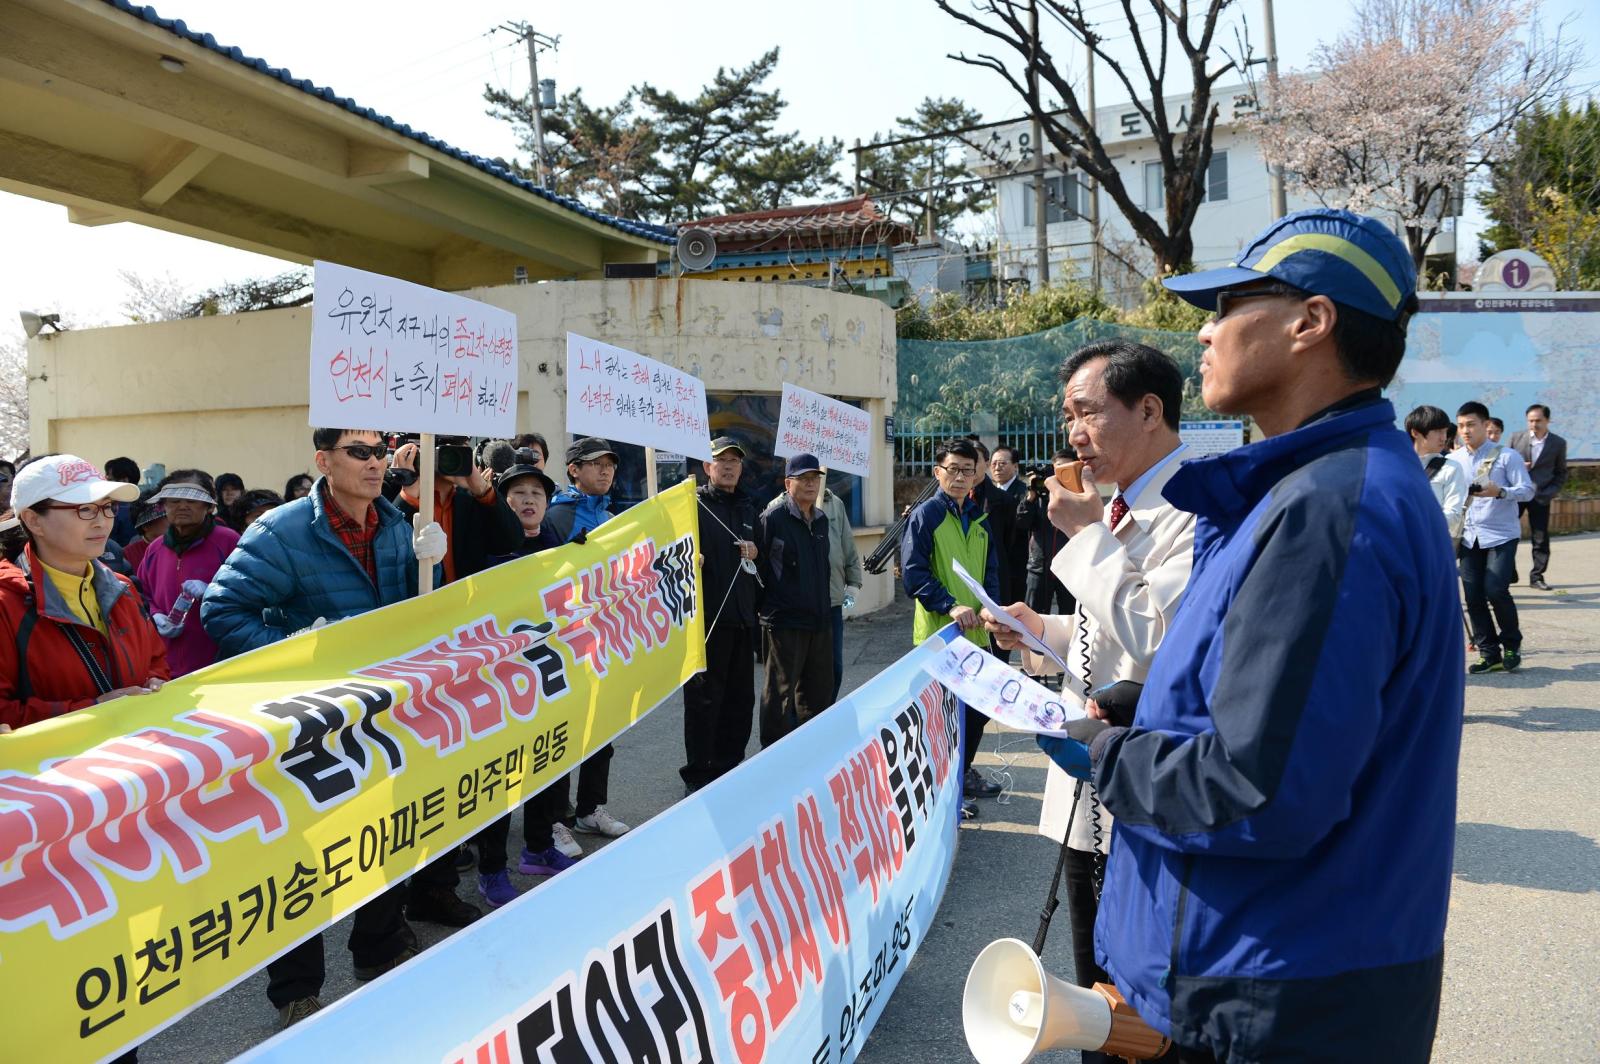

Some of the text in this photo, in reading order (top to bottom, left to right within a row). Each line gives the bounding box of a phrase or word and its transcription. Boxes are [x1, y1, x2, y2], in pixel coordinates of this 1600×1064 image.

[328, 287, 393, 339] 유원지
[75, 721, 568, 1040] 인천럭키송도아파트 입주민 일동
